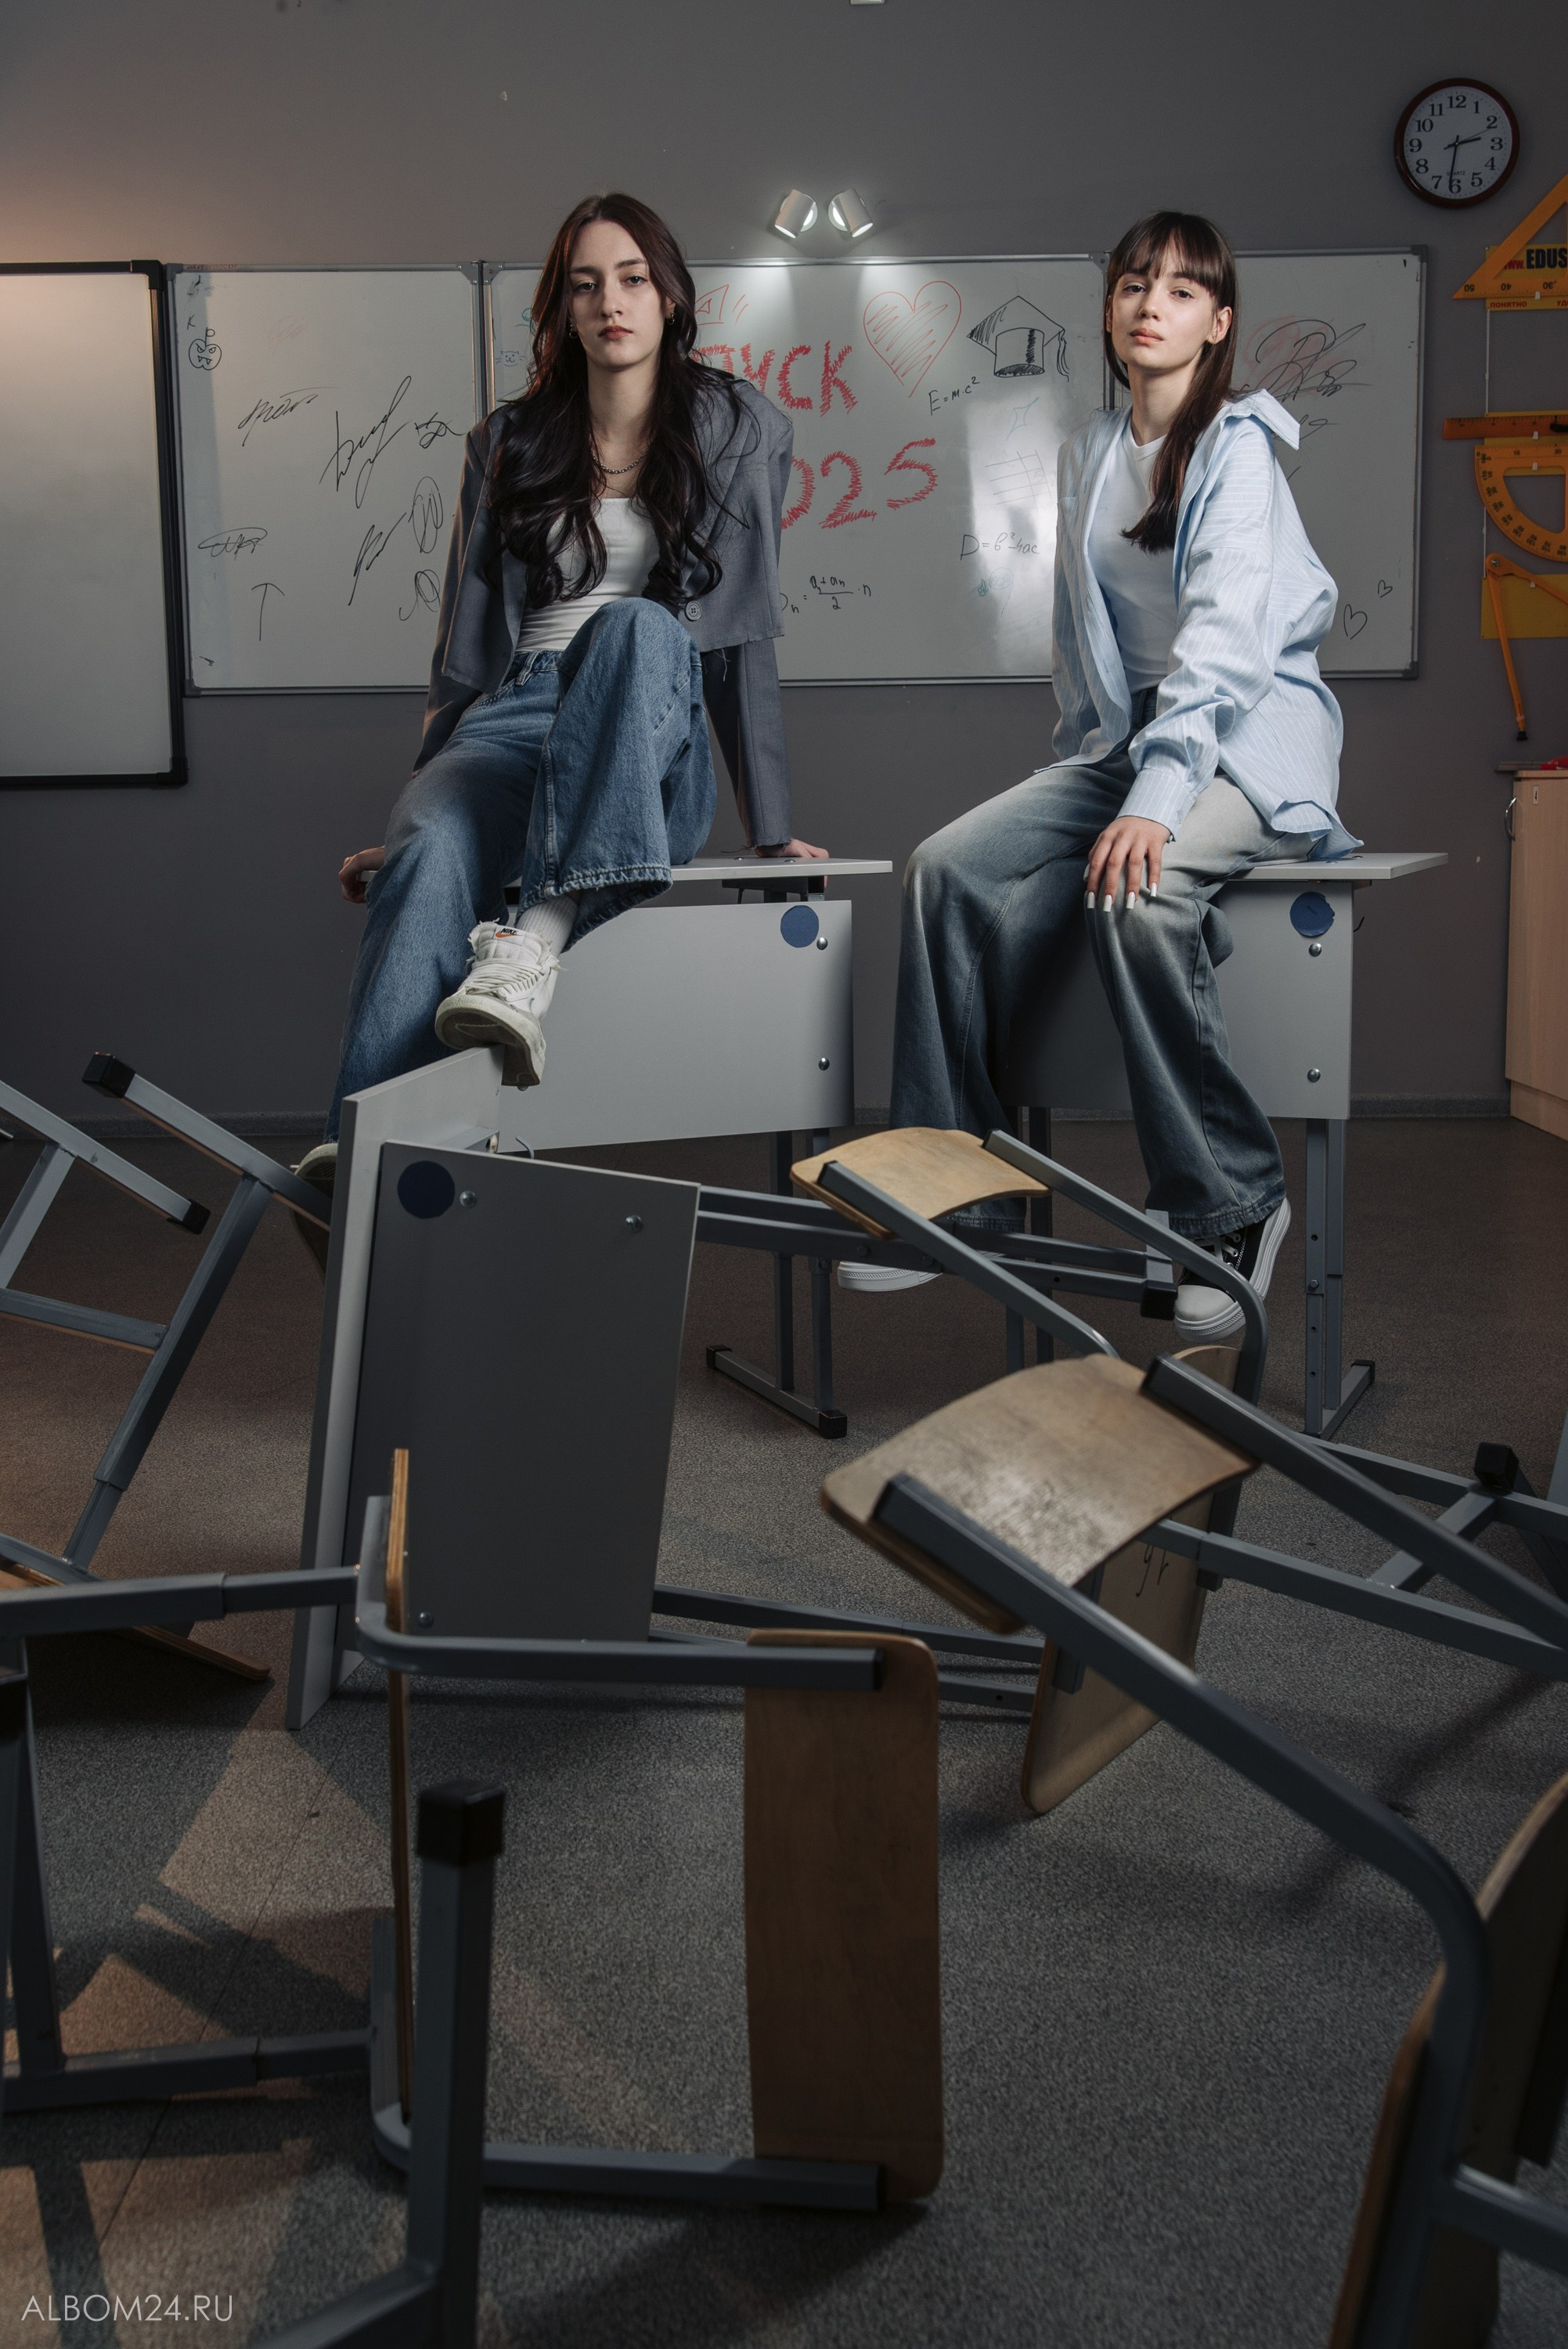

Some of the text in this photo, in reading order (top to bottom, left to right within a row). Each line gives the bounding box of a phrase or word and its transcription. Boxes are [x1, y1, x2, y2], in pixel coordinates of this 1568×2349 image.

[1447, 95, 1466, 108] 12
[1473, 101, 1480, 114] 1
[1429, 103, 1444, 116] 11
[1415, 118, 1433, 132] 10
[1486, 115, 1497, 128] 2
[1409, 138, 1422, 153] 9
[1490, 137, 1503, 150] 3
[1415, 158, 1429, 174] 8
[1484, 157, 1496, 171] 4
[1431, 175, 1443, 189] 7
[1448, 179, 1462, 193] 6
[1471, 172, 1483, 187] 5
